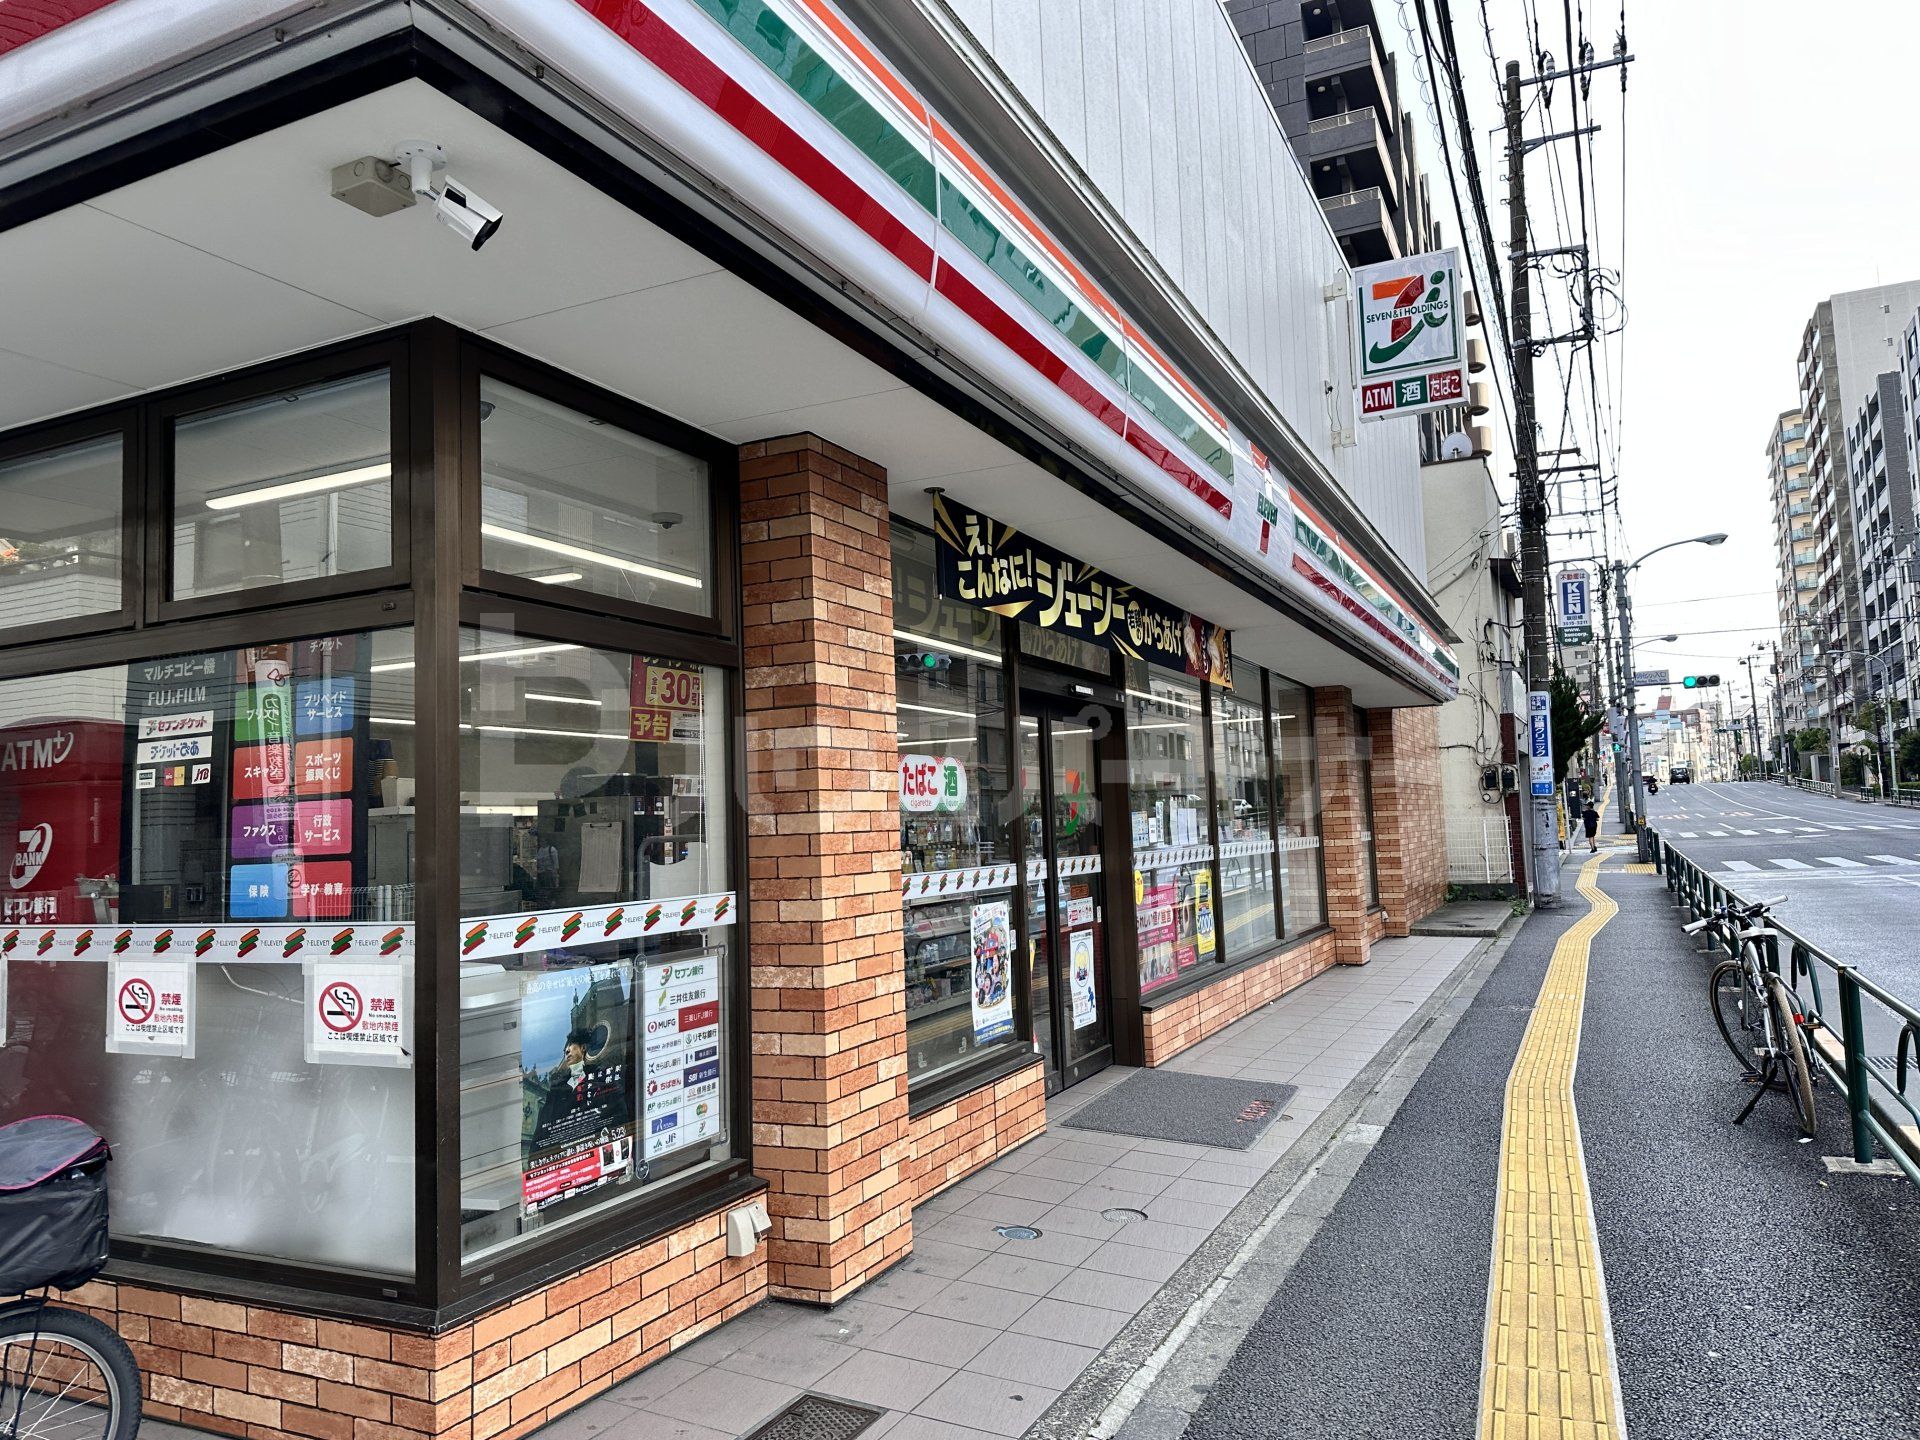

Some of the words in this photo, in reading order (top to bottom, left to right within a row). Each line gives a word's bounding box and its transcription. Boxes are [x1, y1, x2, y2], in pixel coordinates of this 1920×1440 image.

[1404, 300, 1449, 318] HOLDINGS
[1402, 381, 1421, 403] 酒
[1430, 375, 1461, 398] たばこ
[1364, 386, 1393, 409] ATM
[957, 549, 1033, 600] こんなに!
[1035, 558, 1126, 636] ジューシー
[1567, 582, 1581, 614] KEN
[1142, 608, 1182, 657] からあげ
[310, 638, 343, 653] チケット
[144, 657, 216, 681] マルチコピー機
[660, 671, 691, 706] 30
[304, 690, 347, 707] プリペイド
[307, 707, 343, 721] サービス
[157, 714, 208, 733] セブンチケット
[633, 713, 669, 738] 予告
[305, 752, 342, 767] スポーツ
[194, 767, 210, 783] JTB
[305, 768, 341, 782] 振興くじ
[902, 762, 938, 797] たばこ
[943, 764, 958, 797] 酒
[313, 814, 332, 828] 行政
[243, 824, 277, 838] ファクス
[304, 828, 341, 842] サービス
[15, 851, 44, 867] BANK
[248, 884, 270, 898] 保険
[300, 883, 320, 897] 学び
[323, 882, 343, 896] 教育
[674, 964, 704, 979] セブン銀行
[161, 992, 182, 1006] 禁煙
[669, 988, 706, 1005] 三井住友銀行
[370, 997, 395, 1012] 禁煙
[657, 1018, 676, 1029] MUFG
[684, 1009, 713, 1024] 三菱UFJ銀行
[125, 1024, 184, 1034] ここは喫煙禁止区域です
[362, 1020, 399, 1032] 敷地内禁煙
[327, 1031, 399, 1044] ここは喫煙禁止区域です
[692, 1028, 717, 1042] りそな銀行
[655, 1058, 681, 1071] きらぼし銀行
[660, 1078, 682, 1091] ちばぎん
[688, 1072, 698, 1083] SBI
